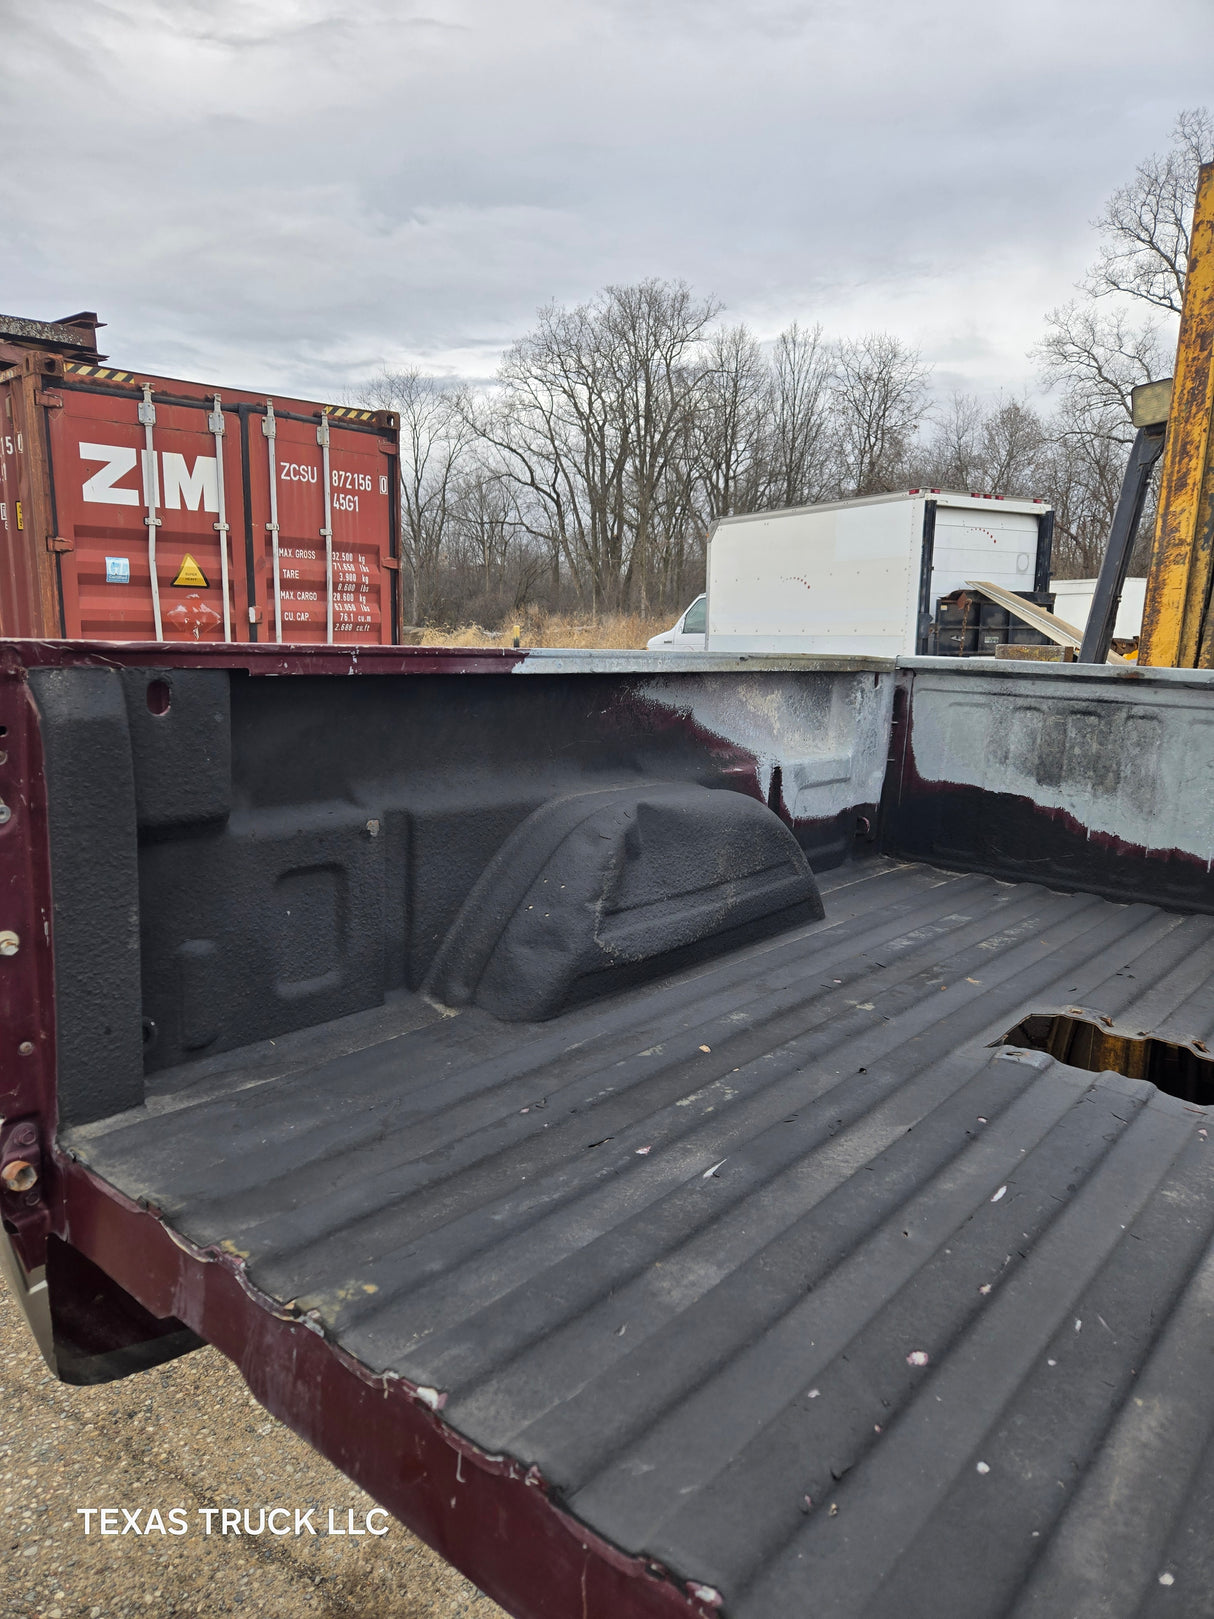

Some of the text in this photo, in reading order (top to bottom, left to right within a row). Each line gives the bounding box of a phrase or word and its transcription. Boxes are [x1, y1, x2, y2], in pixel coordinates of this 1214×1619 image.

[79, 441, 220, 513] ZIM
[280, 462, 388, 494] ZCSU 872156 0
[333, 494, 359, 513] 45G1
[278, 548, 366, 564] MAX. GROSS 32.500 kg
[282, 569, 300, 579] TARE
[361, 574, 369, 585] kg
[280, 591, 296, 600] MAX.
[296, 592, 318, 601] CARGO
[359, 594, 366, 604] kg
[284, 611, 296, 621] CU.
[296, 612, 311, 622] CAP.
[339, 613, 354, 622] 76.1
